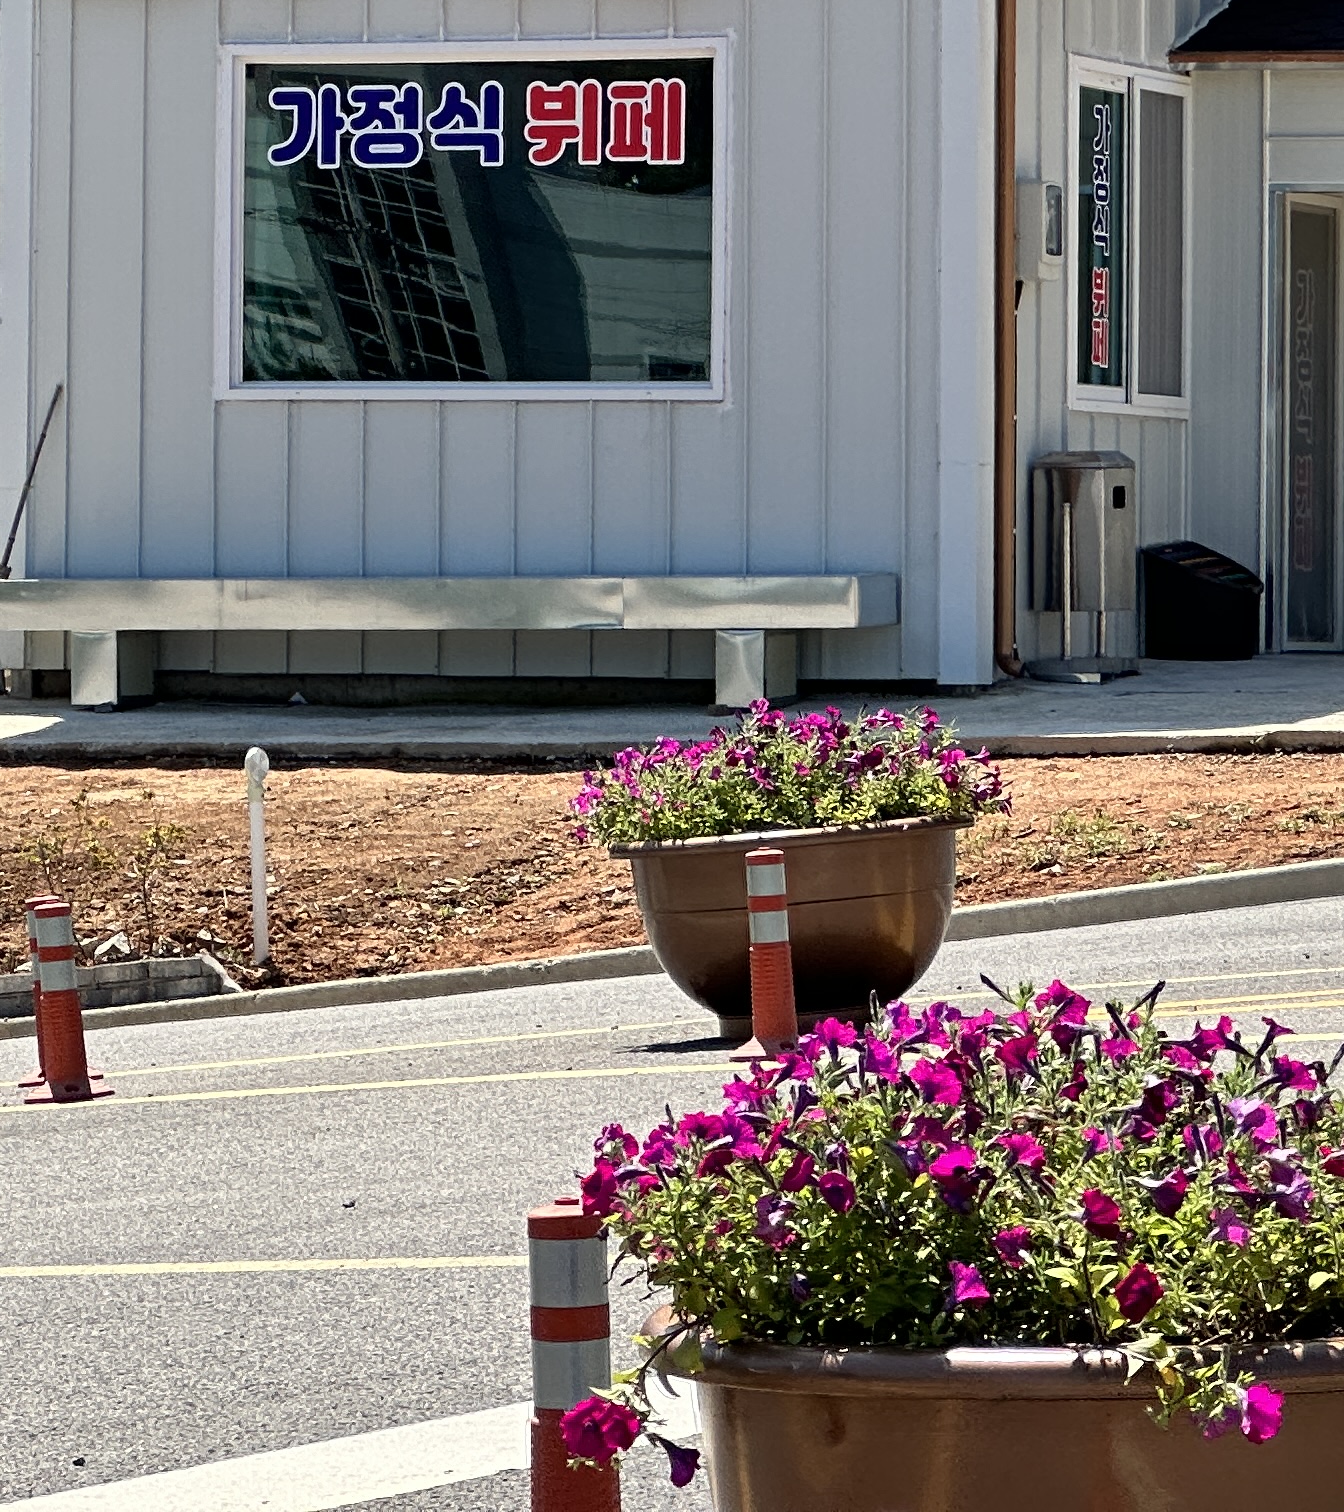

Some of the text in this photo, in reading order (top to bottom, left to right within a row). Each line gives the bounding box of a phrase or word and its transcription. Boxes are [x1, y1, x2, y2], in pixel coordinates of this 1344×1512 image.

[267, 77, 686, 169] 가정식 뷔페
[1091, 103, 1112, 369] 가정식 뷔페
